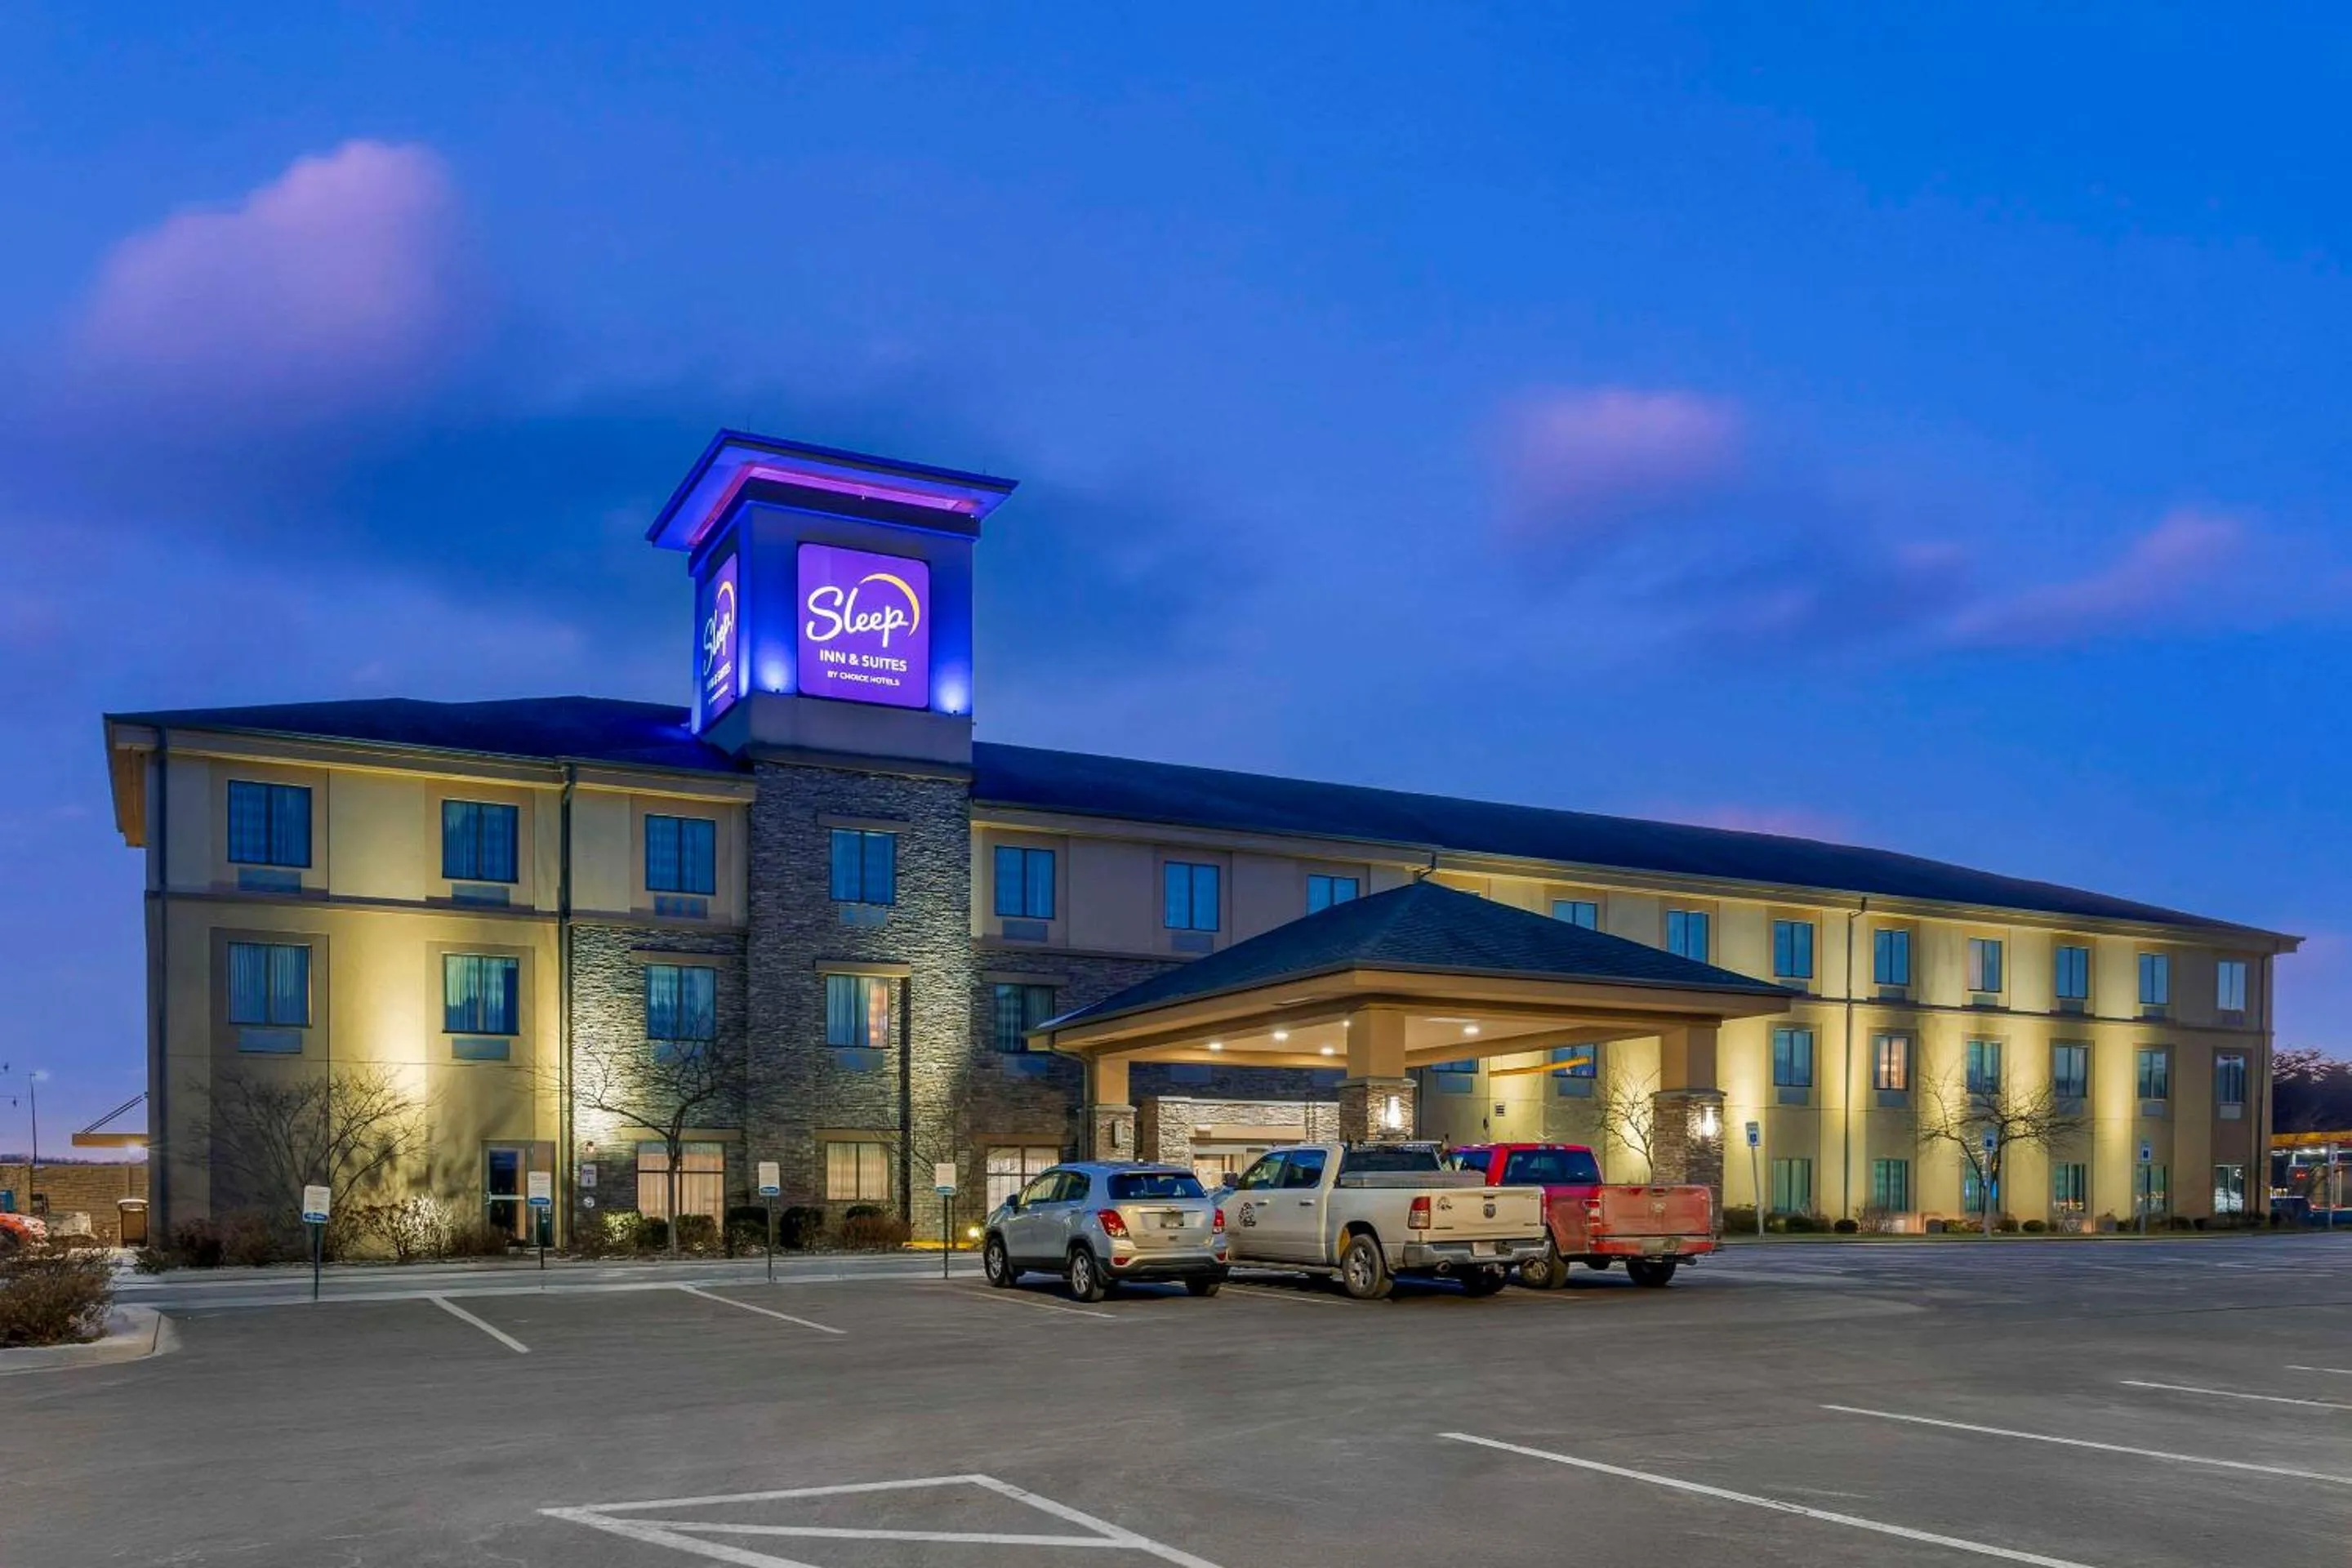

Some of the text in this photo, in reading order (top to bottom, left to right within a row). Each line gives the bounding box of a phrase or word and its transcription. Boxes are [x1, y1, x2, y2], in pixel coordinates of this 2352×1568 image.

[806, 586, 909, 648] Sleep
[703, 608, 732, 676] Sleep
[819, 649, 907, 672] INN & SUITES
[827, 670, 900, 686] BY CHOICE HOTELS
